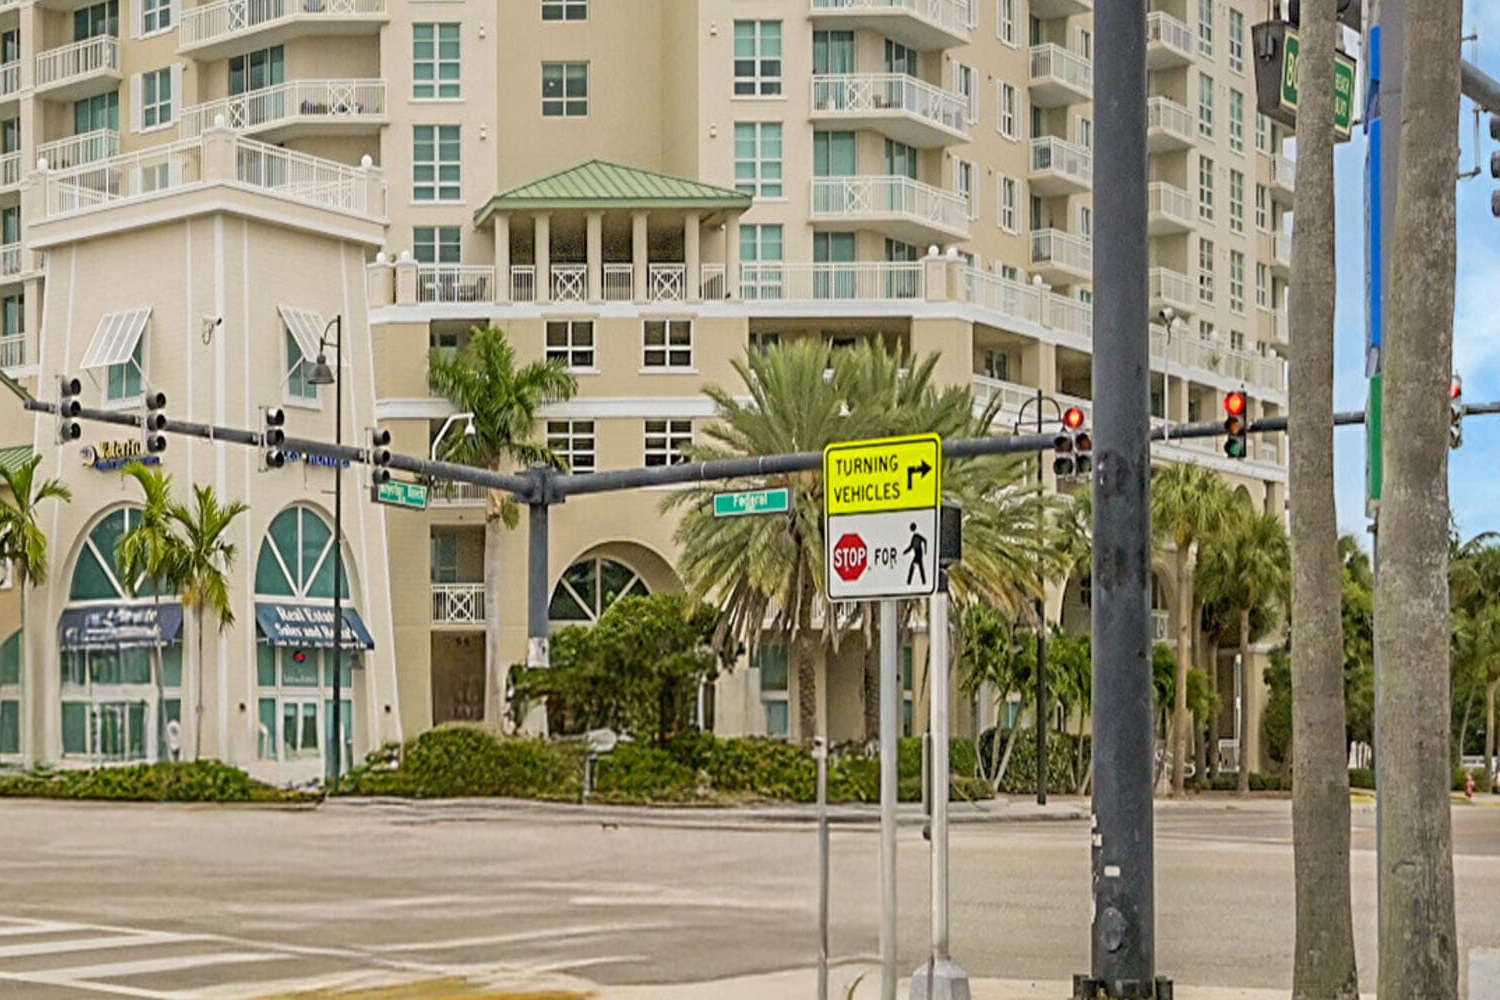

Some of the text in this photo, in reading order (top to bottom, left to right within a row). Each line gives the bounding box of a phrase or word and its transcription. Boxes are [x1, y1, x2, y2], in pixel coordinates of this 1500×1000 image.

[835, 454, 899, 477] TURNING
[833, 482, 901, 504] VEHICLES
[834, 547, 898, 568] STOP FOR
[276, 606, 337, 623] Real Estat
[274, 622, 303, 638] Sales
[301, 624, 323, 638] and
